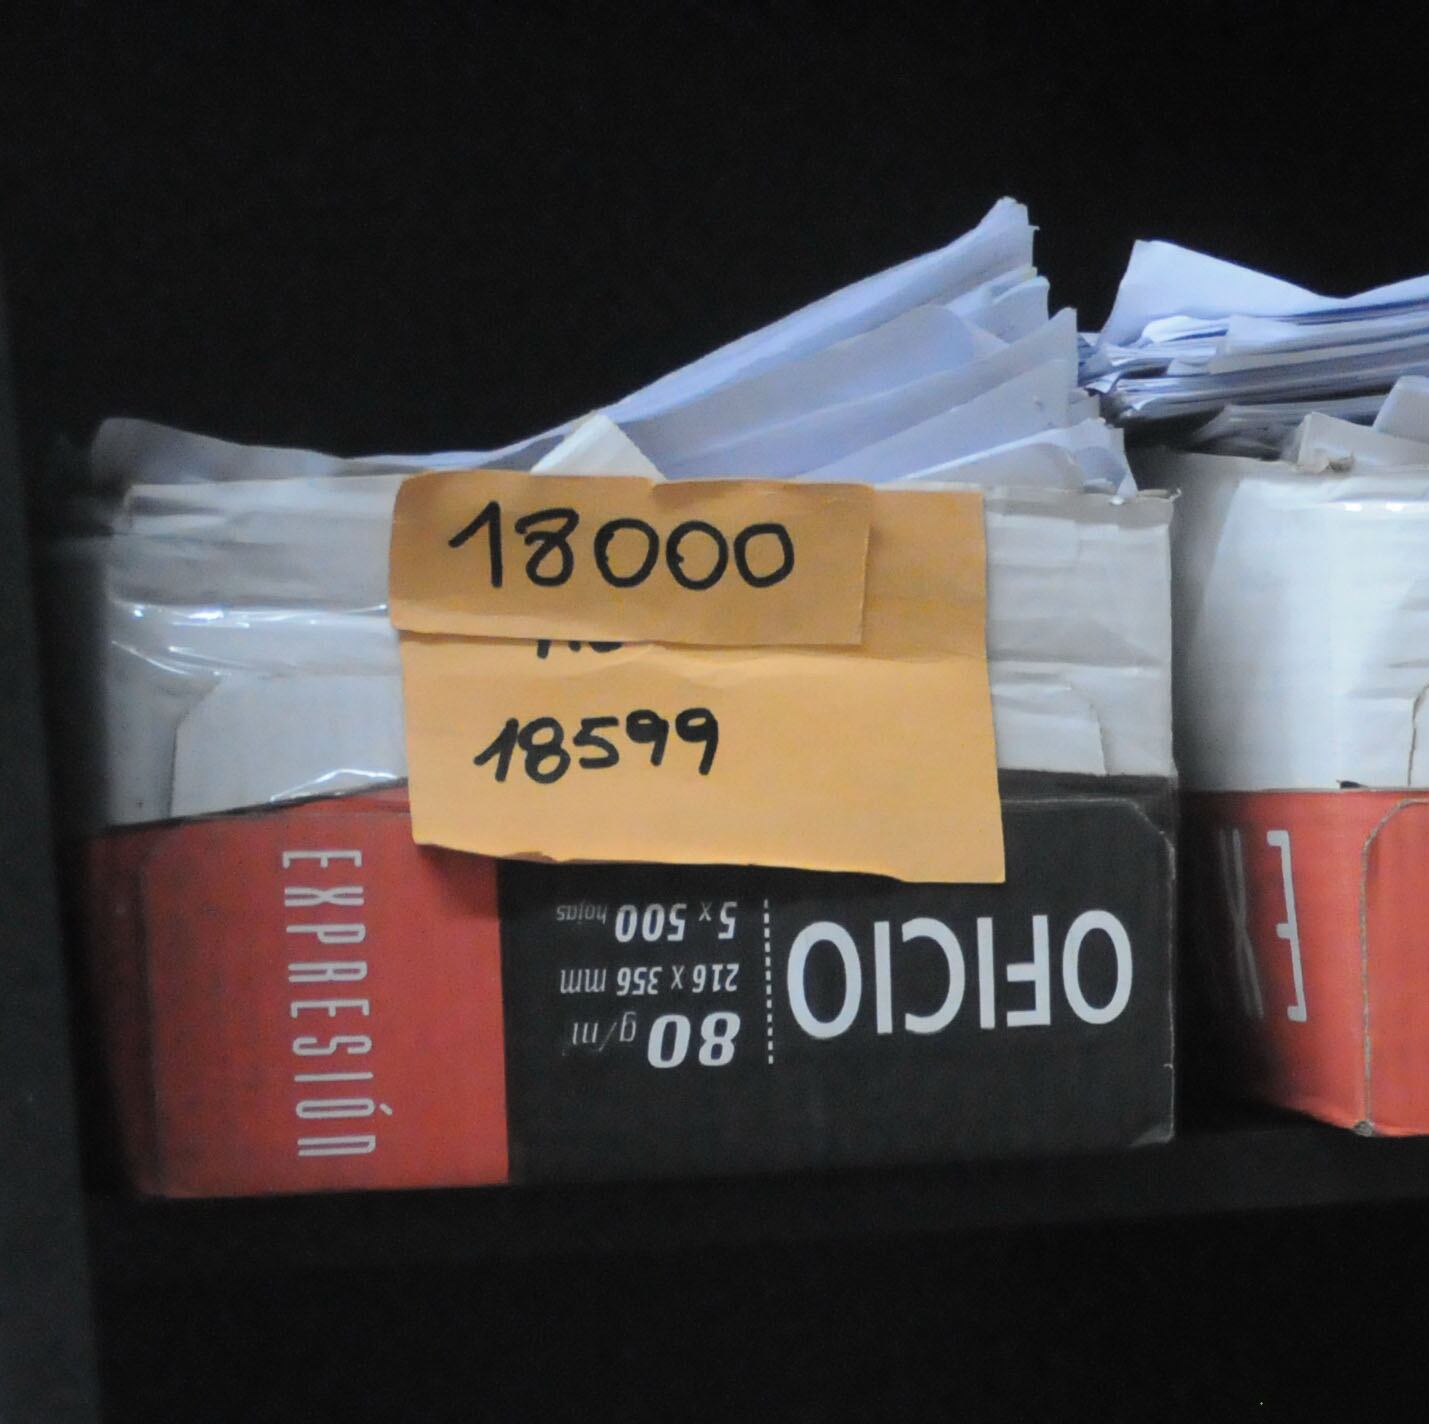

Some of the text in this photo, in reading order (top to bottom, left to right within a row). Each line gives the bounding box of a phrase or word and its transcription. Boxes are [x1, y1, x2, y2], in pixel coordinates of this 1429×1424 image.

[448, 501, 796, 591] 18000
[474, 707, 719, 785] 18599
[556, 905, 606, 924] hojas
[614, 903, 686, 943] 500
[715, 902, 738, 940] 5
[559, 968, 606, 994] mm
[616, 966, 663, 997] 356
[689, 963, 740, 994] 216
[786, 909, 1134, 1040] OFICIO
[647, 1012, 741, 1069] 80
